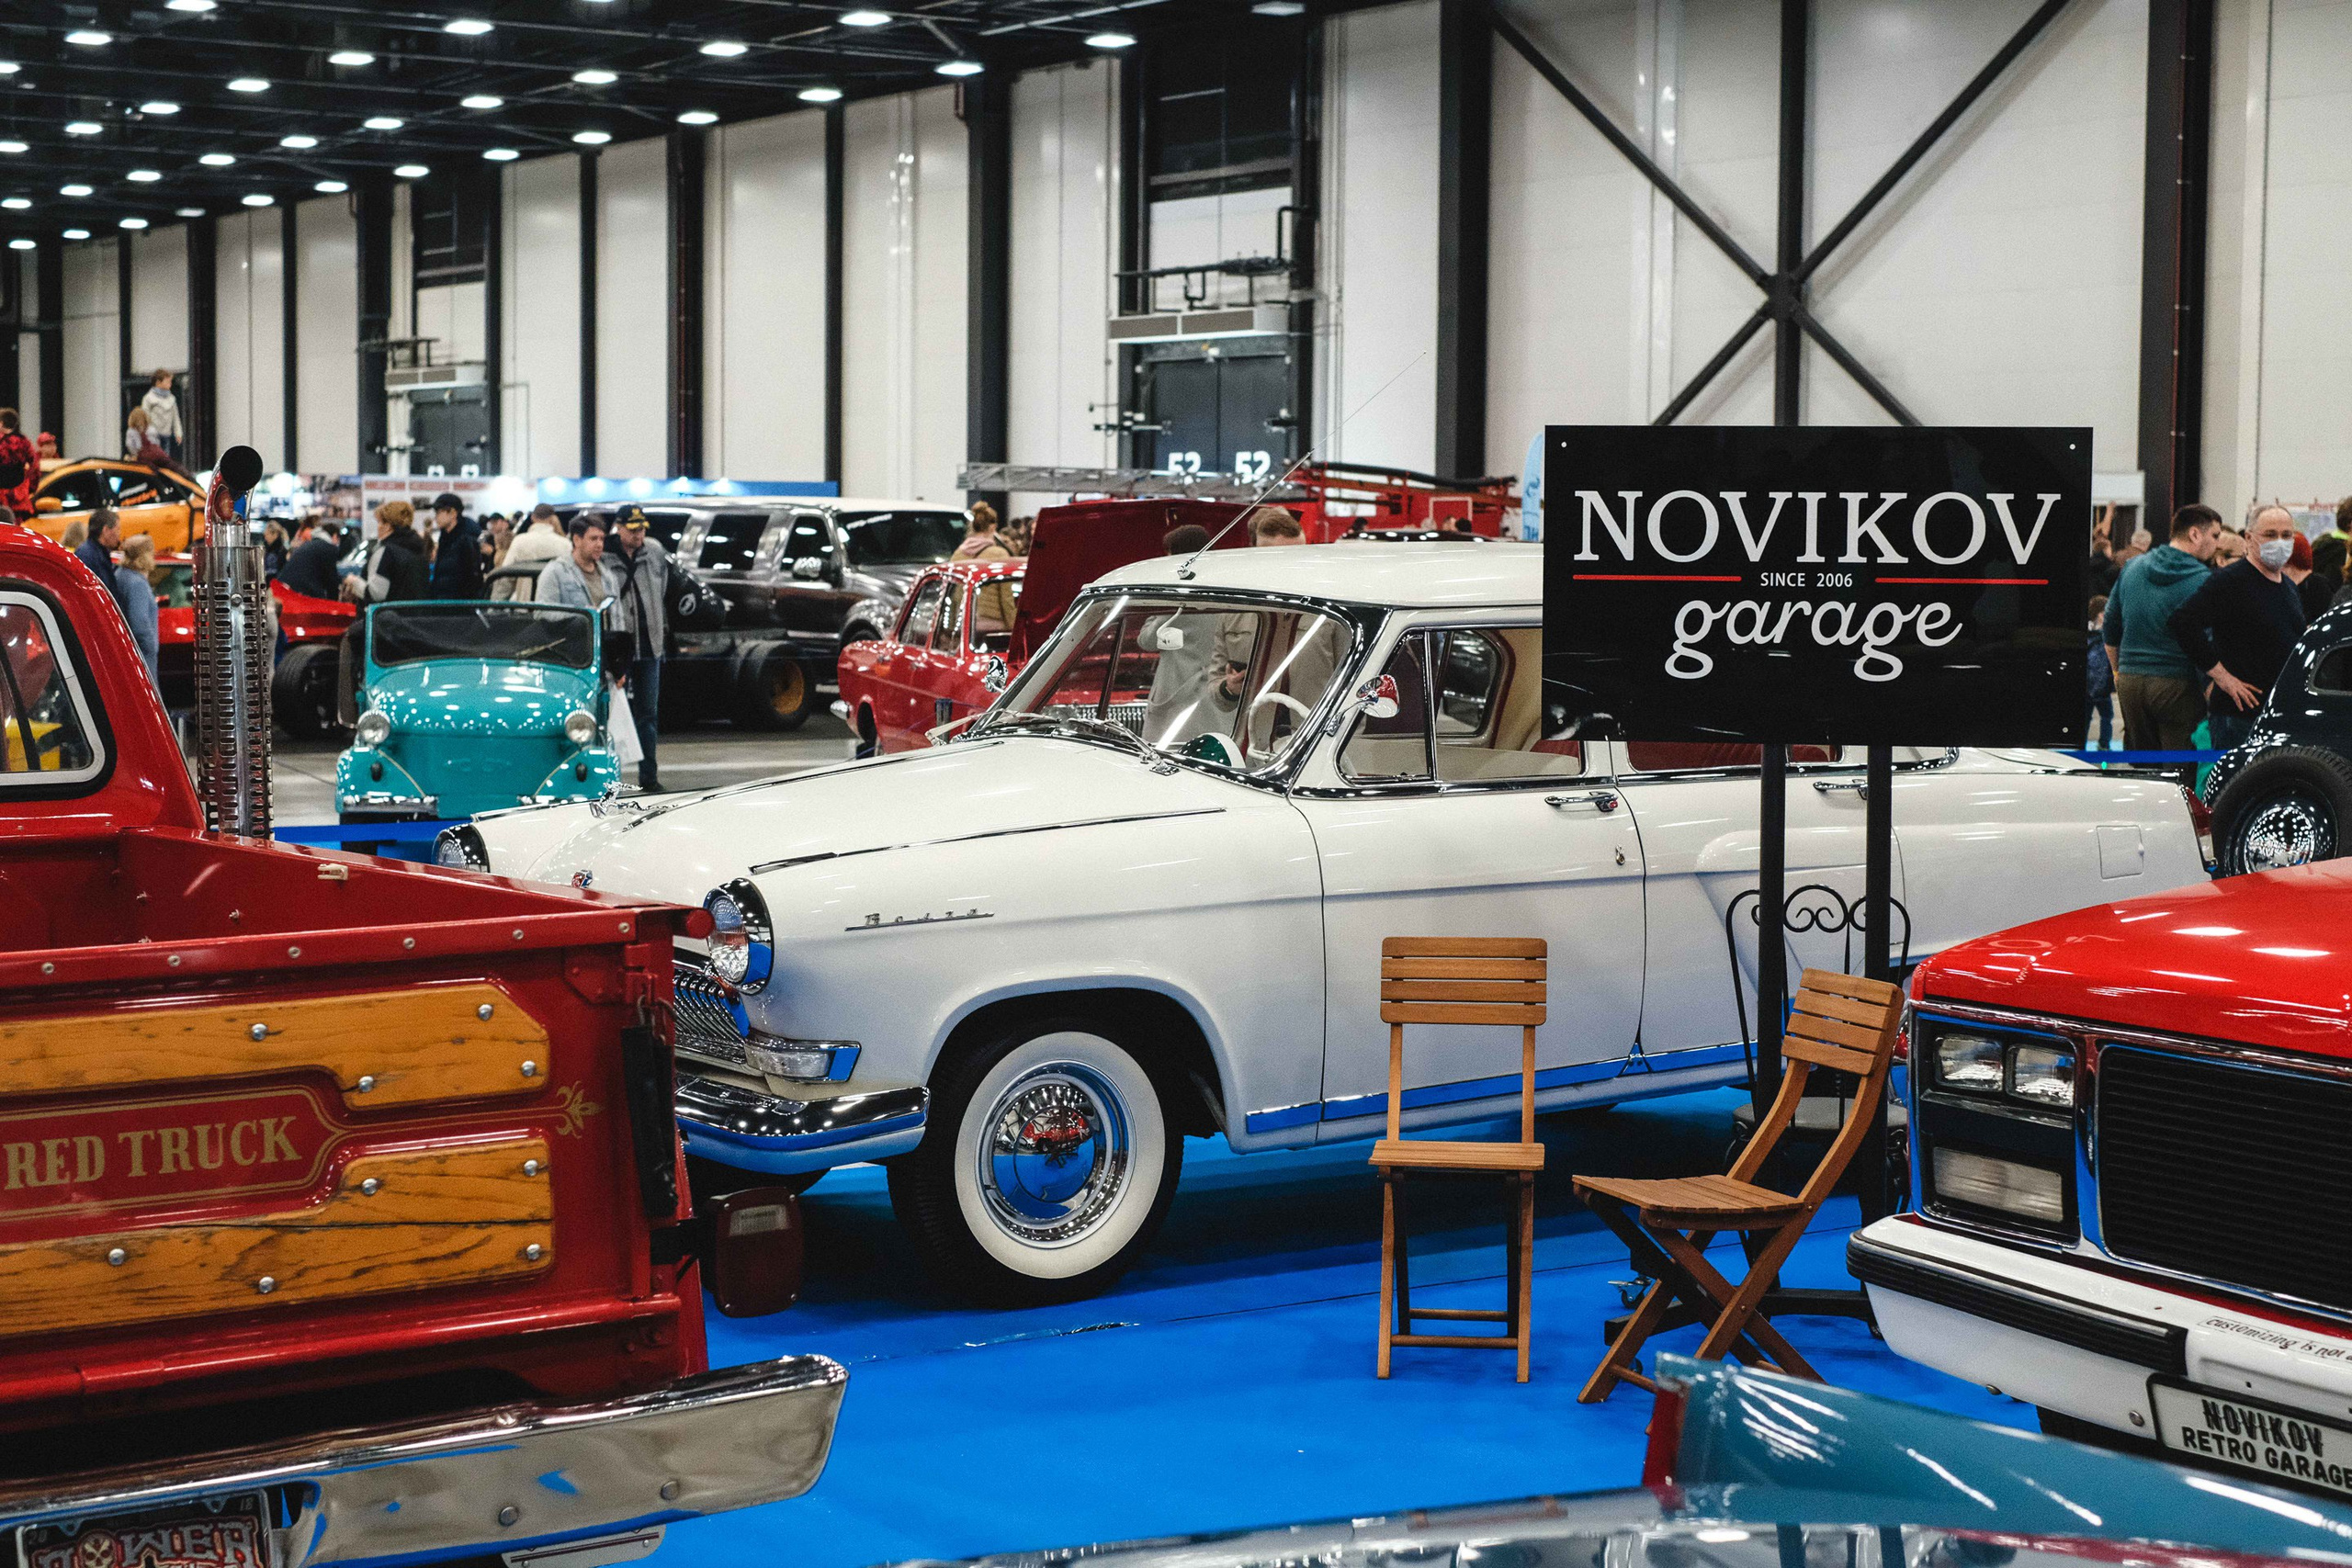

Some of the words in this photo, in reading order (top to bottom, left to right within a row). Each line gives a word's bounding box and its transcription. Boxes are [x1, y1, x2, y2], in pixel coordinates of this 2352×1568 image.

[1168, 451, 1202, 474] 52
[1235, 450, 1272, 479] 52
[1572, 489, 2062, 566] NOVIKOV
[1760, 571, 1806, 588] SINCE
[1815, 572, 1854, 588] 2006
[1664, 599, 1963, 682] garage
[3, 1134, 107, 1190] RED
[117, 1115, 303, 1179] TRUCK
[2205, 1318, 2298, 1349] customizing
[2300, 1339, 2317, 1351] is
[2314, 1346, 2346, 1359] not
[2181, 1426, 2257, 1464] RETRO
[2264, 1446, 2352, 1490] GARAGE
[2201, 1398, 2324, 1458] NOVIKOV
